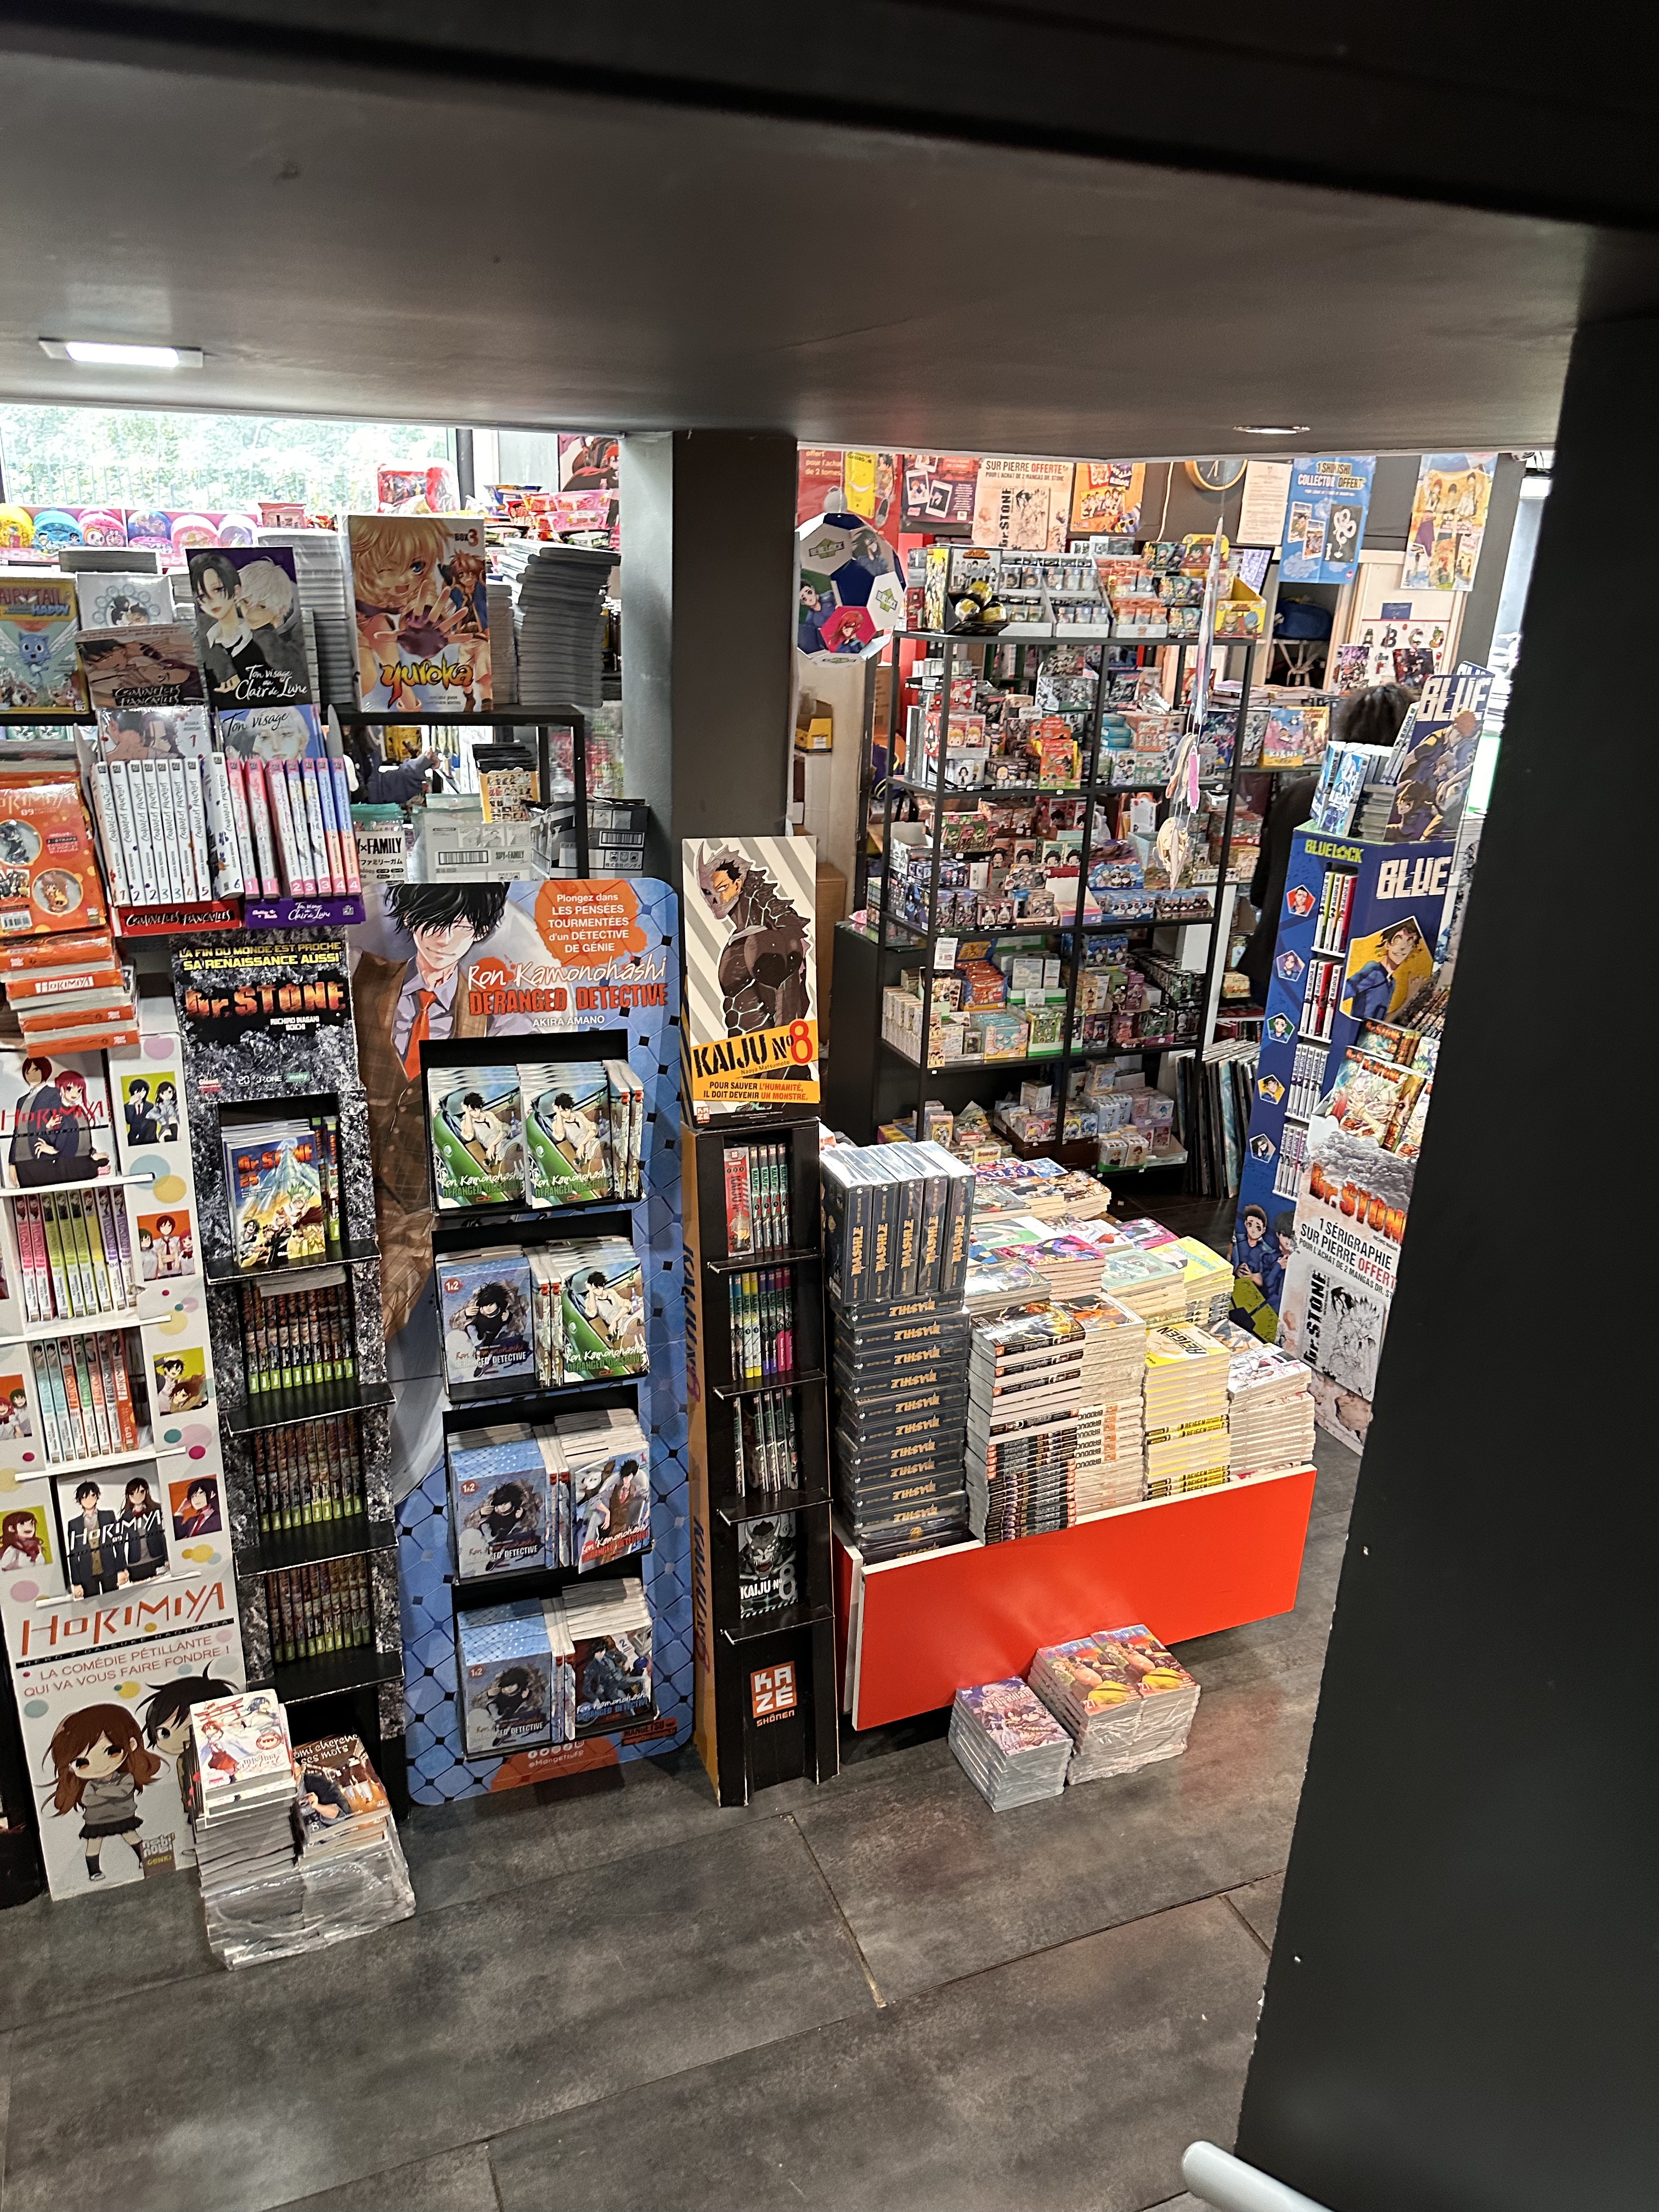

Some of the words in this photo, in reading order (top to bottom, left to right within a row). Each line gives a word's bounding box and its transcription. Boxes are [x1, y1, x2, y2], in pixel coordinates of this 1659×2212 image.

[986, 460, 1002, 471] SUR
[1003, 461, 1030, 472] PIERRE
[1297, 474, 1335, 488] COLLECTOR
[245, 664, 264, 680] Ton
[264, 668, 293, 682] visage
[235, 680, 268, 701] Clair
[277, 676, 308, 698] Lune
[1416, 676, 1493, 721] BLUE
[223, 710, 249, 733] Ton
[252, 712, 290, 730] visage
[234, 878, 241, 889] 6
[1376, 856, 1453, 900] BLUE
[202, 885, 210, 896] 5
[247, 881, 253, 890] 1
[267, 881, 273, 890] 1
[292, 883, 302, 893] 2
[305, 883, 314, 891] 3
[321, 880, 330, 890] 3
[336, 881, 345, 890] 4
[349, 880, 358, 890] 4
[133, 891, 141, 901] 2
[149, 889, 158, 900] 2
[162, 888, 169, 899] 3
[174, 888, 182, 899] 3
[557, 894, 594, 903] Plongez
[596, 893, 619, 901] dans
[552, 906, 573, 916] LES
[575, 904, 624, 915] PENSÉES
[548, 917, 629, 929] TOURMENTÉES
[549, 932, 569, 941] d'un
[571, 929, 629, 940] DÉTECTIVE
[179, 949, 193, 958] LA
[195, 948, 213, 957] FIN
[215, 947, 231, 957] DU
[233, 946, 273, 956] MONDE
[274, 944, 295, 953] EST
[297, 941, 342, 952] PROCHE
[565, 944, 580, 953] DE
[582, 942, 615, 952] GÉNIE
[183, 961, 202, 971] SA
[205, 955, 298, 970] RENAISSANCE
[300, 952, 340, 964] AUSSI
[468, 964, 507, 991] Ron
[513, 953, 667, 988] Kamonohashi
[469, 987, 568, 1016] DERANGED
[575, 983, 668, 1011] DETECTIVE
[532, 1017, 565, 1028] AKIRA
[567, 1015, 605, 1025] AMANO
[692, 1034, 768, 1079] KAIJU
[759, 1060, 790, 1072] Matsumoto
[709, 1081, 729, 1089] POUR
[731, 1082, 758, 1090] SAUVER
[759, 1082, 803, 1092] L'HUMANITÉ,
[239, 1172, 259, 1188] 25
[441, 1176, 459, 1188] Ron
[534, 1176, 551, 1188] Ron
[1339, 1181, 1407, 1245] STON
[1319, 1218, 1324, 1231] 1
[1325, 1222, 1392, 1271] SÉRIGRAPHIE
[1301, 1223, 1319, 1244] SUR
[1321, 1235, 1356, 1267] PIERRE
[1357, 1257, 1397, 1290] OFFERT
[1299, 1237, 1313, 1252] POUR
[1335, 1259, 1343, 1269] DE
[1343, 1265, 1348, 1273] 2
[1348, 1267, 1374, 1289] MANGAS
[1156, 1327, 1207, 1355] REIGEN
[493, 1351, 527, 1364] DETECTIVE
[71, 1509, 162, 1550] HORIMIYA
[740, 1579, 771, 1600] KAIJU
[21, 1582, 225, 1656] HORIMIYA
[84, 1637, 146, 1654] DAISUKE
[155, 1620, 228, 1639] HAGIWARA
[40, 1670, 58, 1681] LA
[62, 1654, 127, 1676] COMÉDIE
[131, 1635, 213, 1661] PÉTILLANTE
[24, 1685, 49, 1697] QUI
[53, 1680, 73, 1690] VA
[76, 1669, 116, 1686] VOUS
[121, 1660, 161, 1677] FAIRE
[165, 1647, 224, 1666] FONDRE
[1138, 1682, 1150, 1692] 27
[1083, 1699, 1096, 1709] 27
[301, 1754, 320, 1765] ses
[320, 1743, 350, 1759] mots
[311, 1821, 319, 1831] 8
